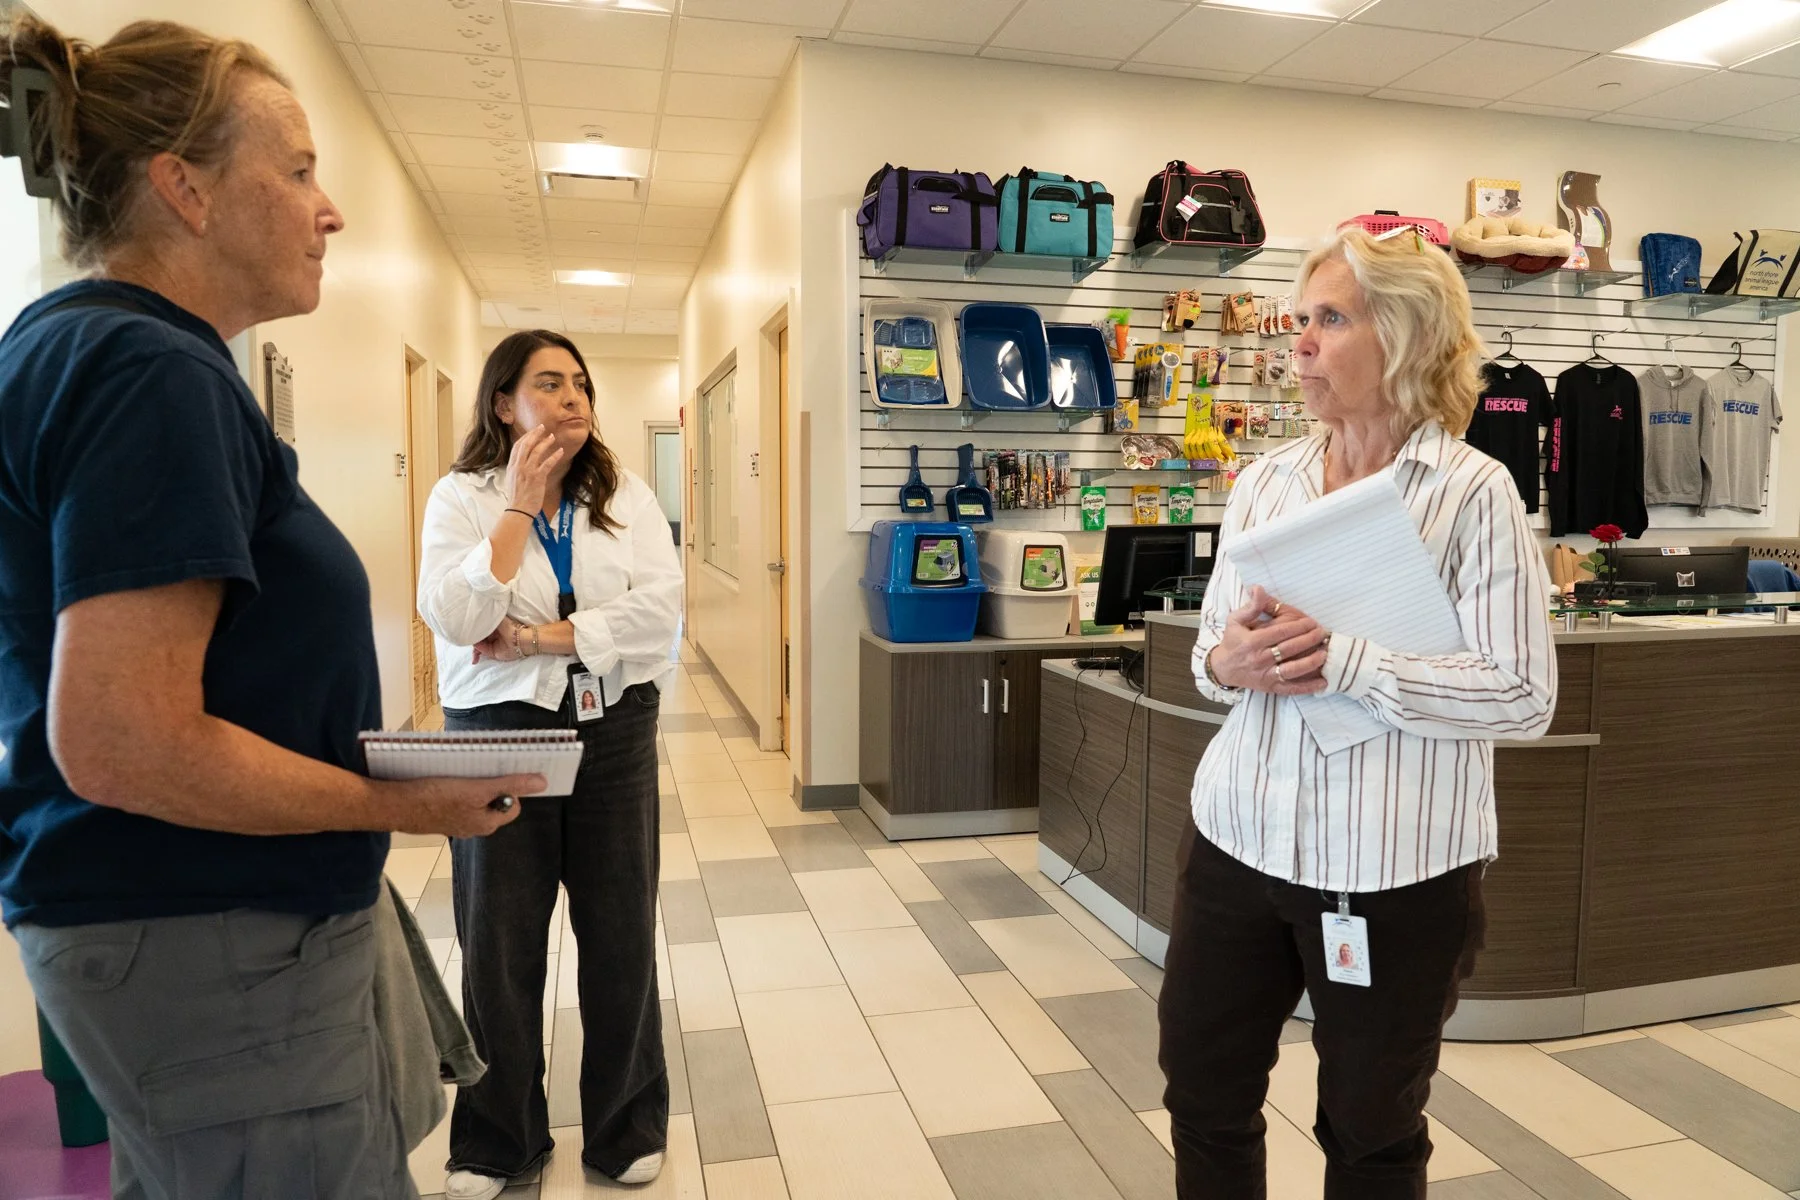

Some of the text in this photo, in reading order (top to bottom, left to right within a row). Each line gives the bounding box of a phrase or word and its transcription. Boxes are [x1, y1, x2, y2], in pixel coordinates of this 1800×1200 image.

[1761, 278, 1780, 286] league
[1484, 400, 1528, 413] RESCUE
[1722, 401, 1760, 416] RESCUE
[1649, 413, 1693, 425] RESCUE
